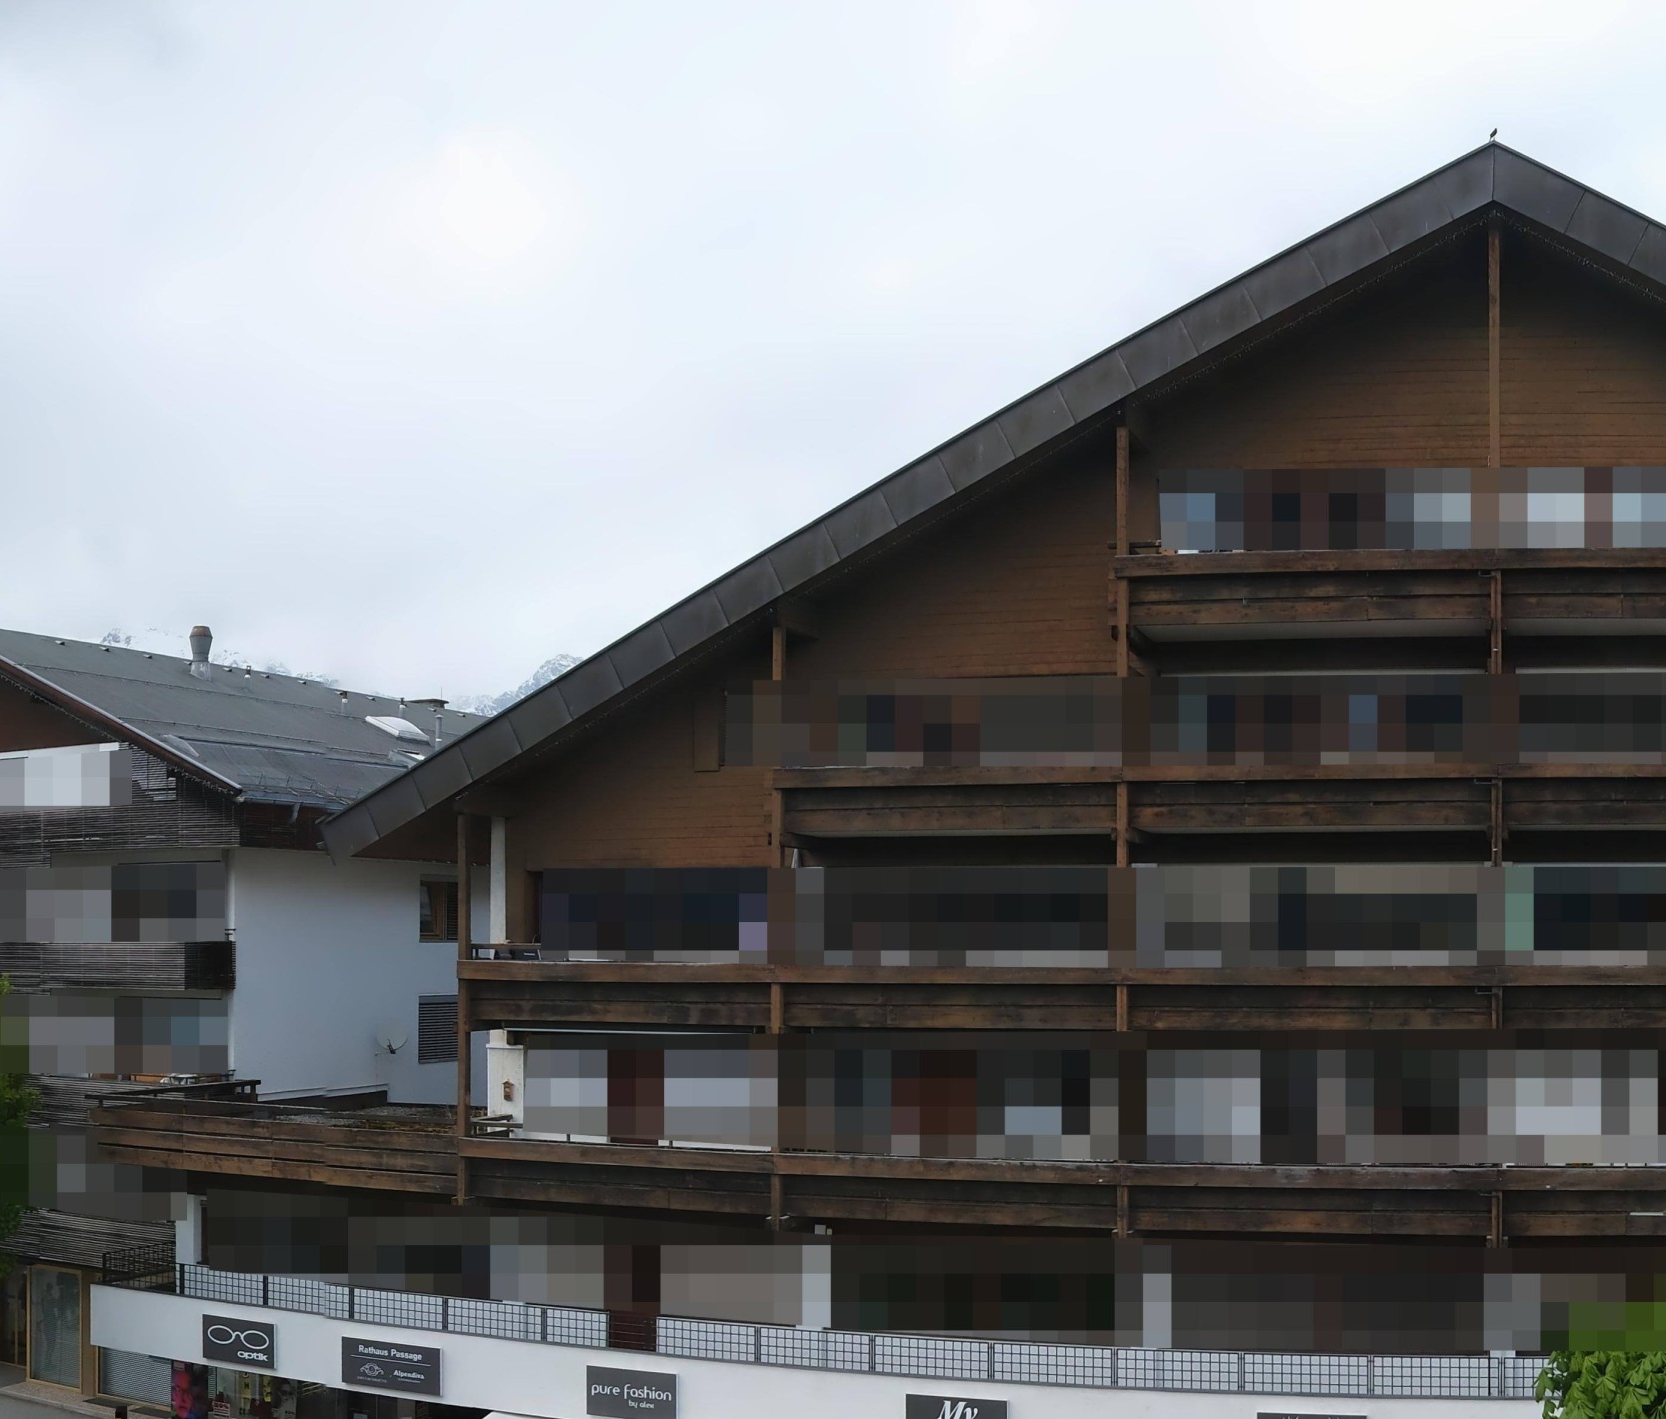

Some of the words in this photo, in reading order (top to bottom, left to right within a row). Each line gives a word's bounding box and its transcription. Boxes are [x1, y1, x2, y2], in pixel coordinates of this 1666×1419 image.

[237, 1350, 269, 1362] optik
[358, 1344, 389, 1357] Rathaus
[390, 1348, 423, 1362] Passage
[591, 1383, 621, 1397] pure
[623, 1383, 672, 1402] fashion
[628, 1399, 638, 1409] by
